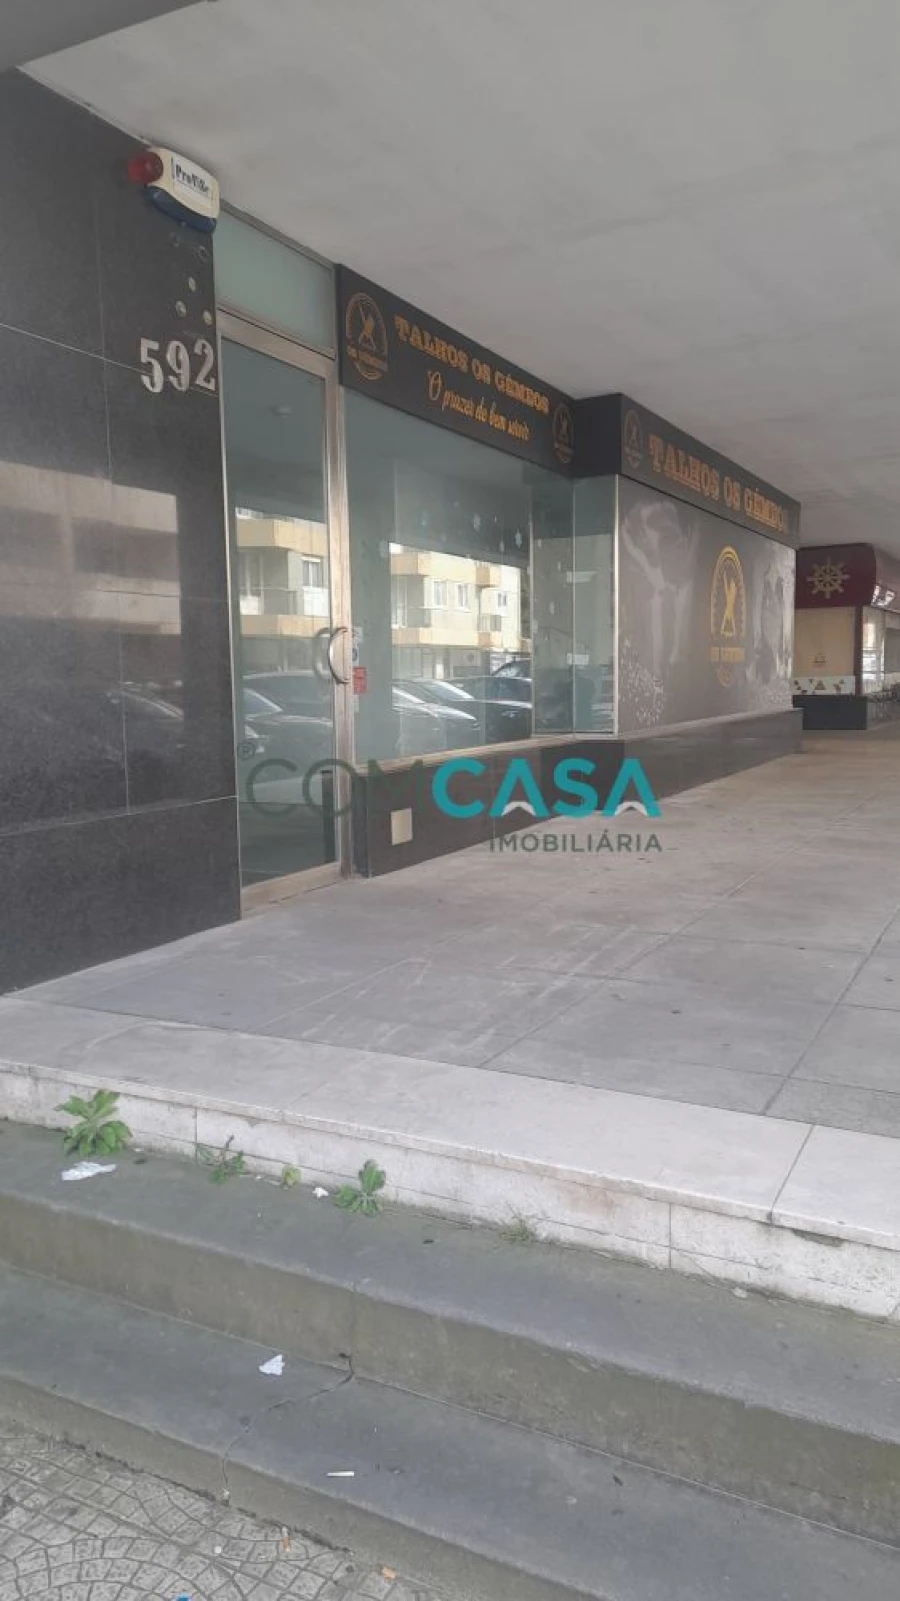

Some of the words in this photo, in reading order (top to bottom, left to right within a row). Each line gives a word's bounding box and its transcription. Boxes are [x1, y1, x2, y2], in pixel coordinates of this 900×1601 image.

[140, 337, 216, 394] 592
[394, 314, 469, 373] TALHOS
[472, 358, 491, 385] OS
[647, 434, 719, 502] TALHOS
[723, 476, 741, 512] OS
